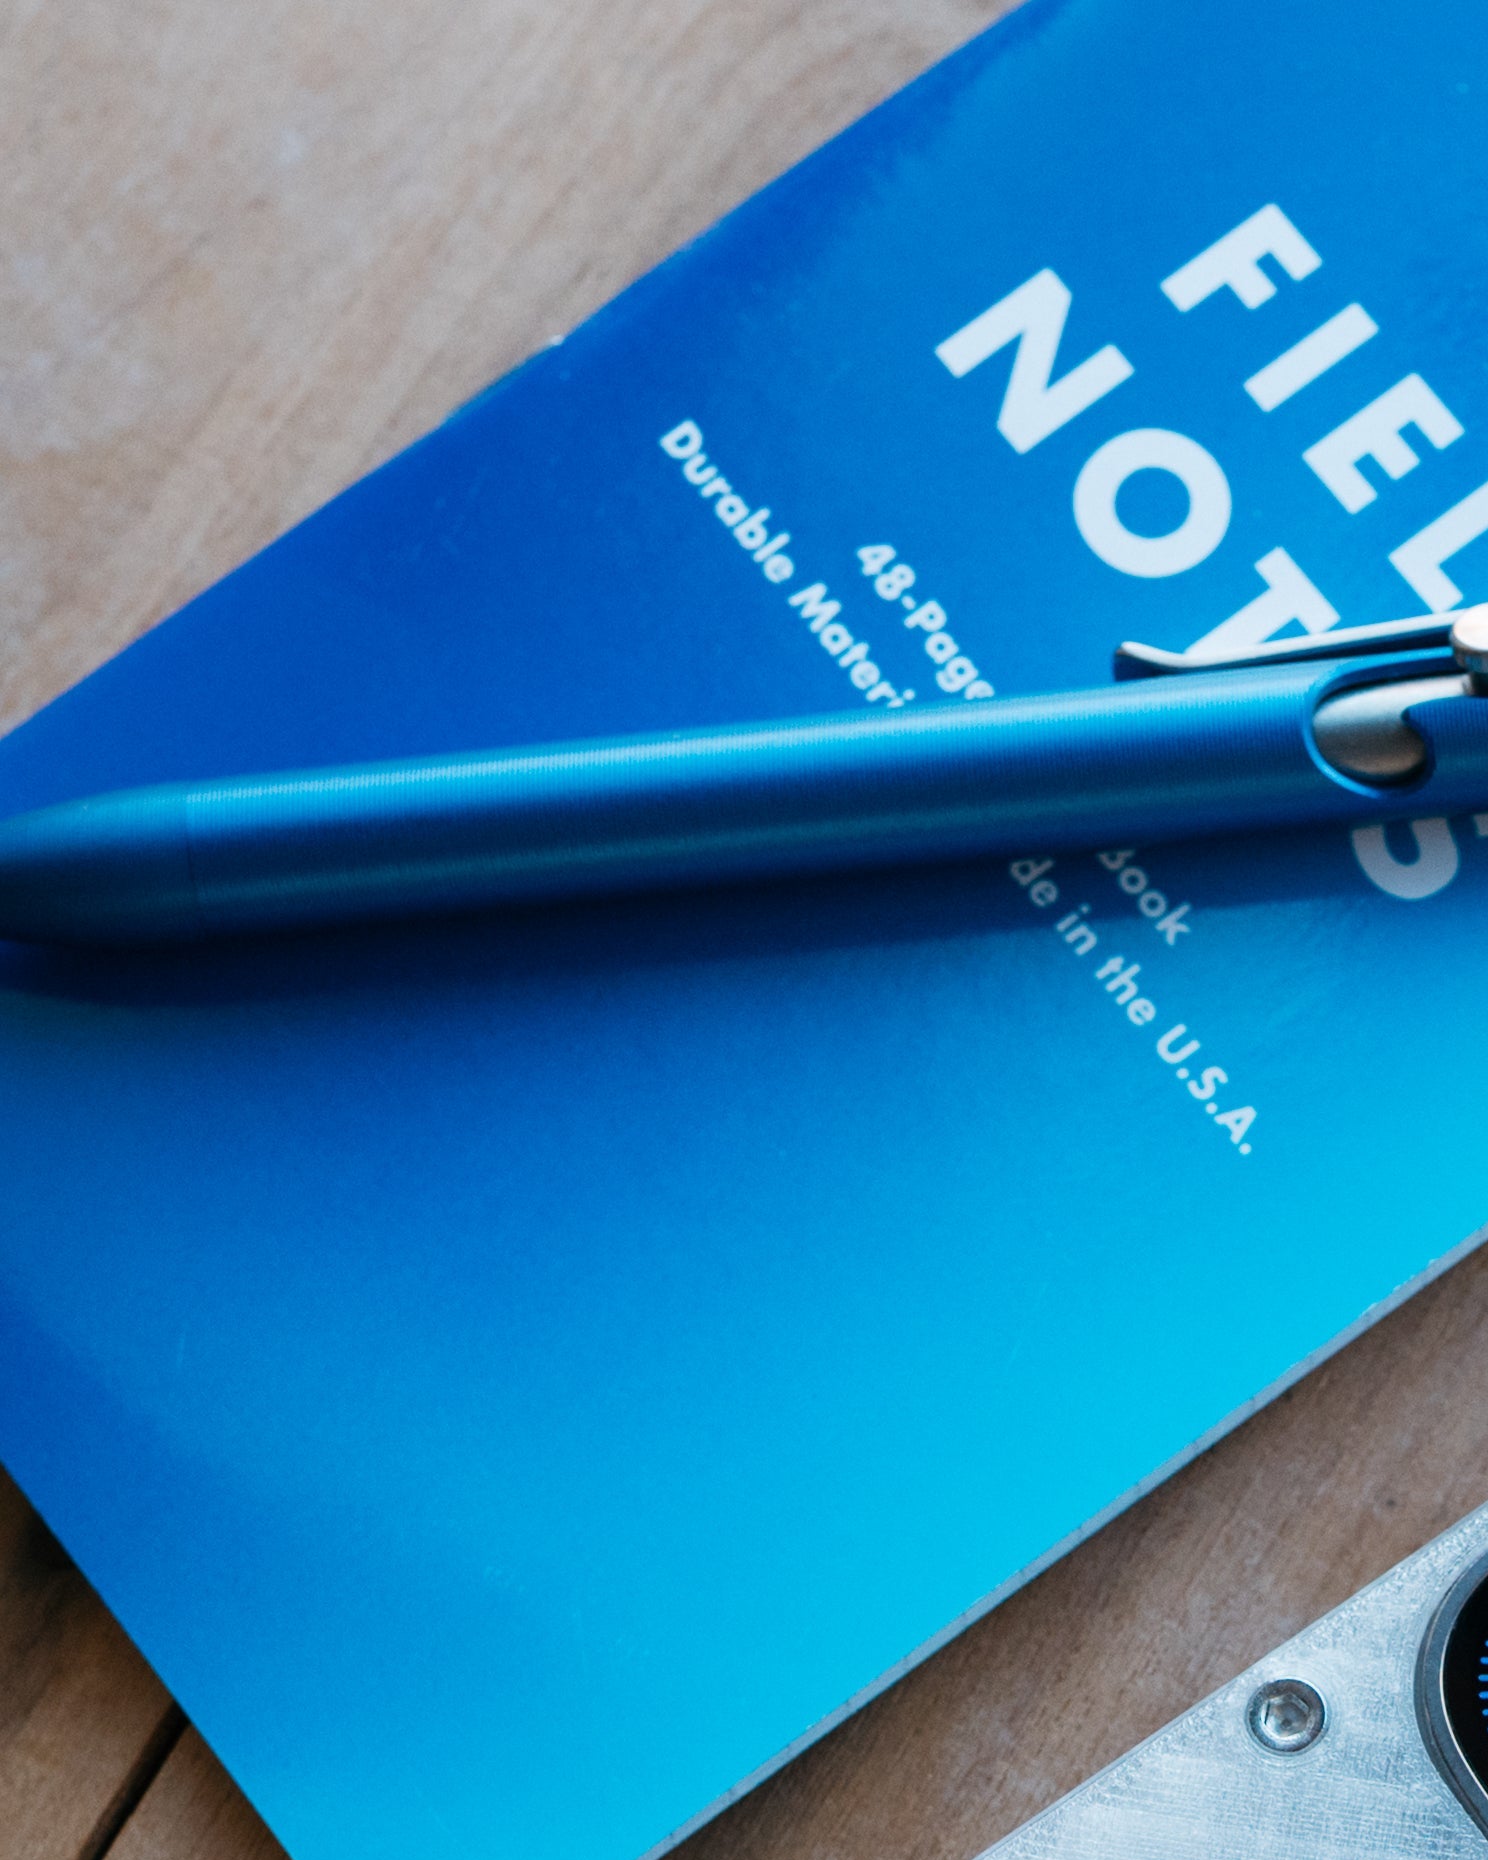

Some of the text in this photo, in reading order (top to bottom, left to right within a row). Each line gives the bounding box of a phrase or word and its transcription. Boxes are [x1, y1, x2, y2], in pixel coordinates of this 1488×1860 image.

[659, 419, 916, 708] Durable Materi
[1010, 858, 1258, 1155] de in the U.S.A.
